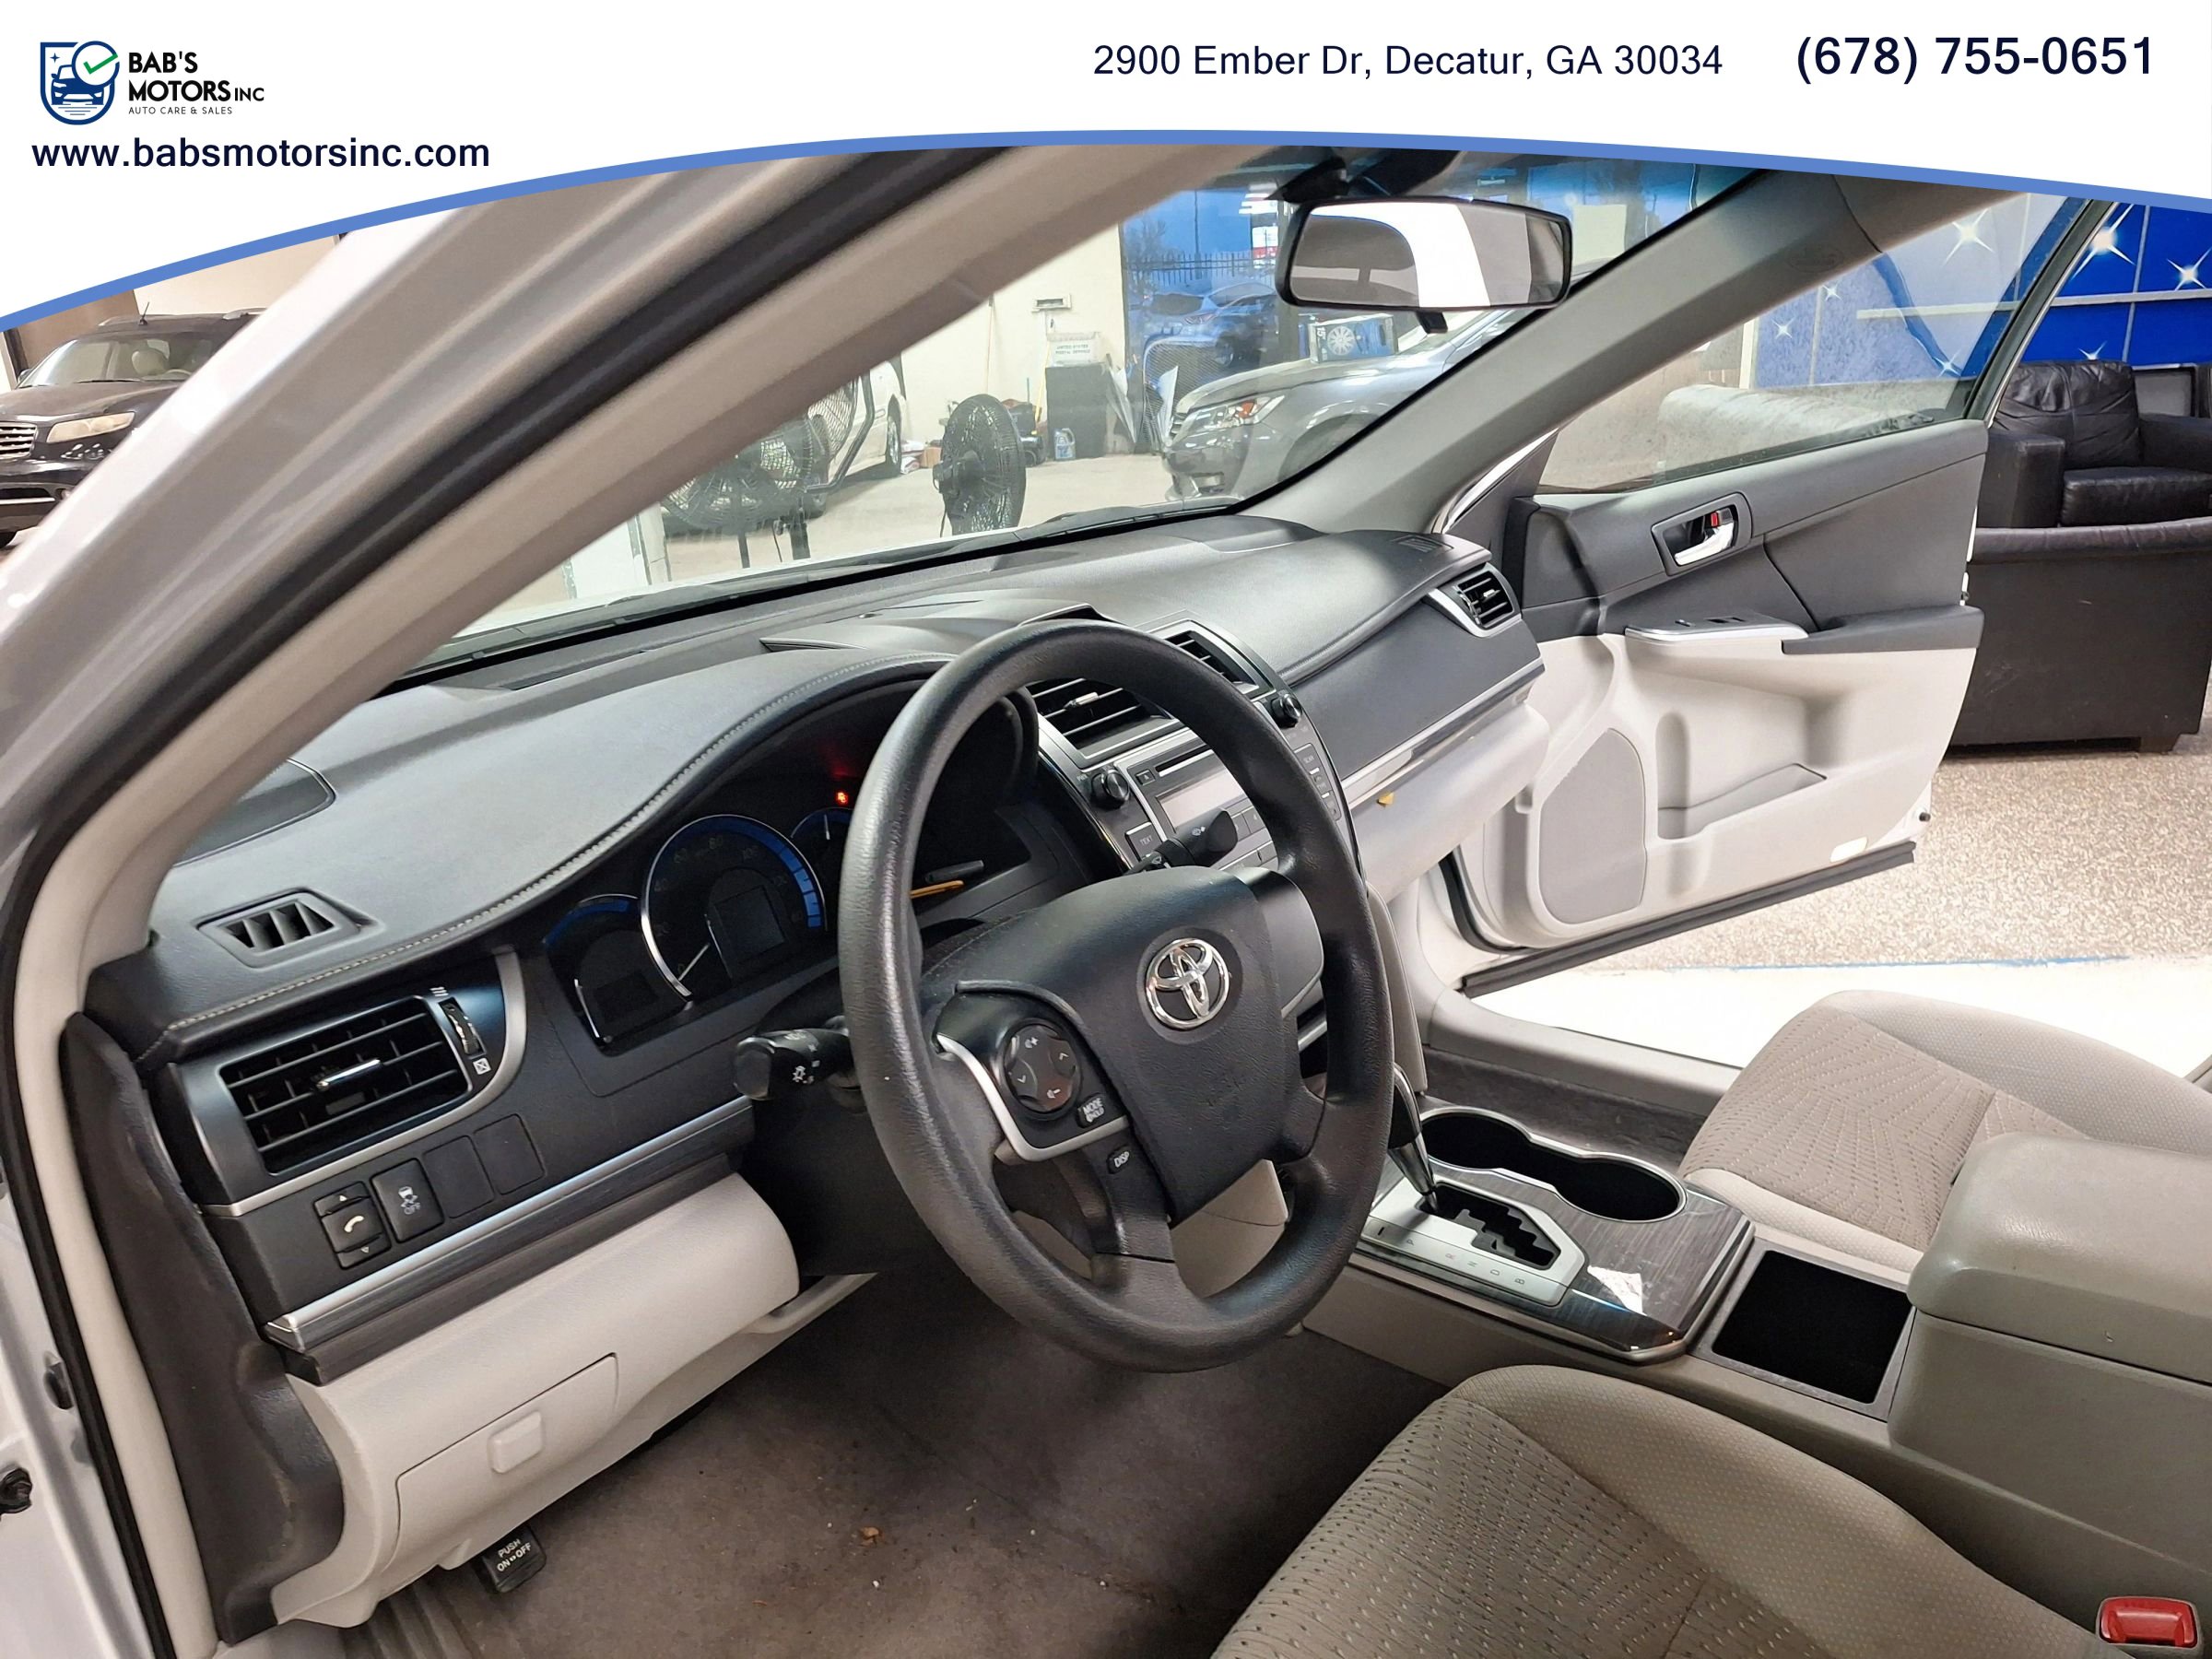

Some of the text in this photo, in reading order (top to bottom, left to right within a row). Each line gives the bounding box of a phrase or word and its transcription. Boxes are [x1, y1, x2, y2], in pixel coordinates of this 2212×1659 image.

[497, 1542, 531, 1571] ON OFF
[498, 1538, 521, 1558] PUSH
